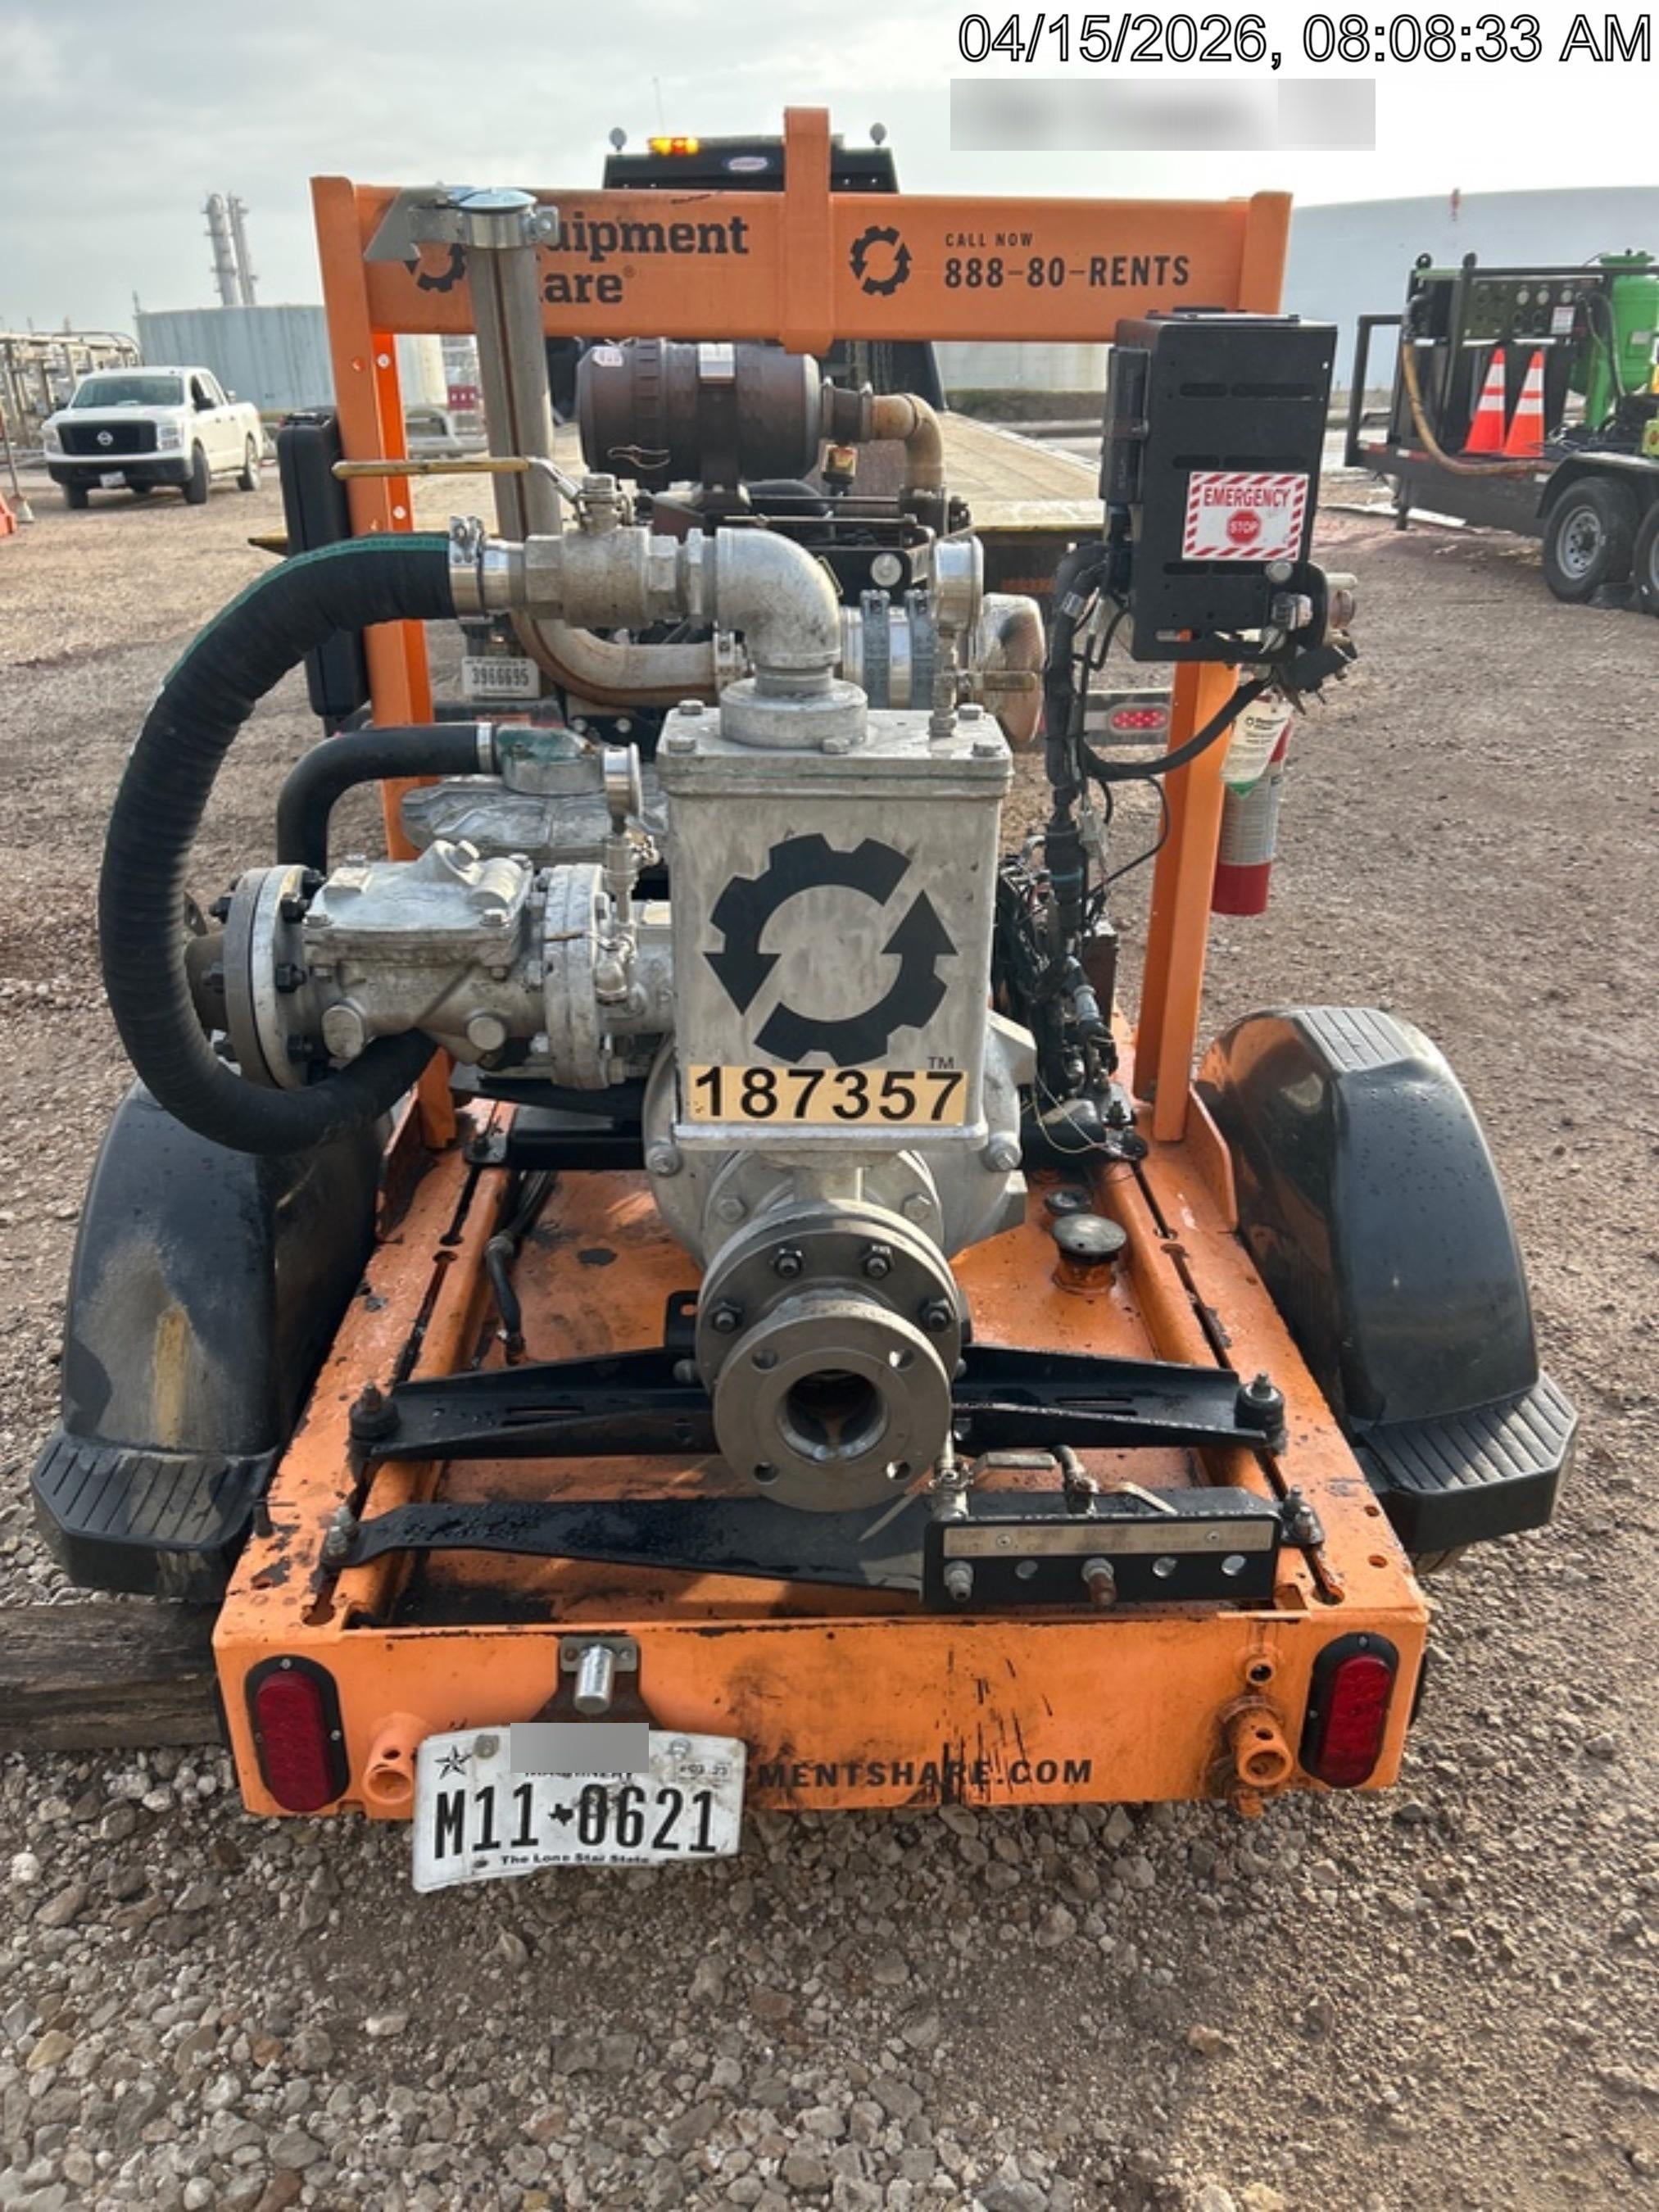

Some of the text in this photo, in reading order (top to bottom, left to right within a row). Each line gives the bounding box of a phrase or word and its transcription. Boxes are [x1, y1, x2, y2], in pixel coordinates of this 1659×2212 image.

[538, 211, 750, 262] uipment
[945, 232, 1033, 247] CALL NOW
[944, 255, 1190, 288] 888-80-RENTS
[540, 271, 623, 303] are
[1203, 487, 1291, 507] EMERGENCY
[1229, 520, 1259, 535] STOP
[927, 1056, 955, 1069] TM
[696, 1066, 963, 1121] 187357
[746, 1760, 1091, 1788] MENTSHARE.COM
[501, 1852, 650, 1865] The Lone Star State
